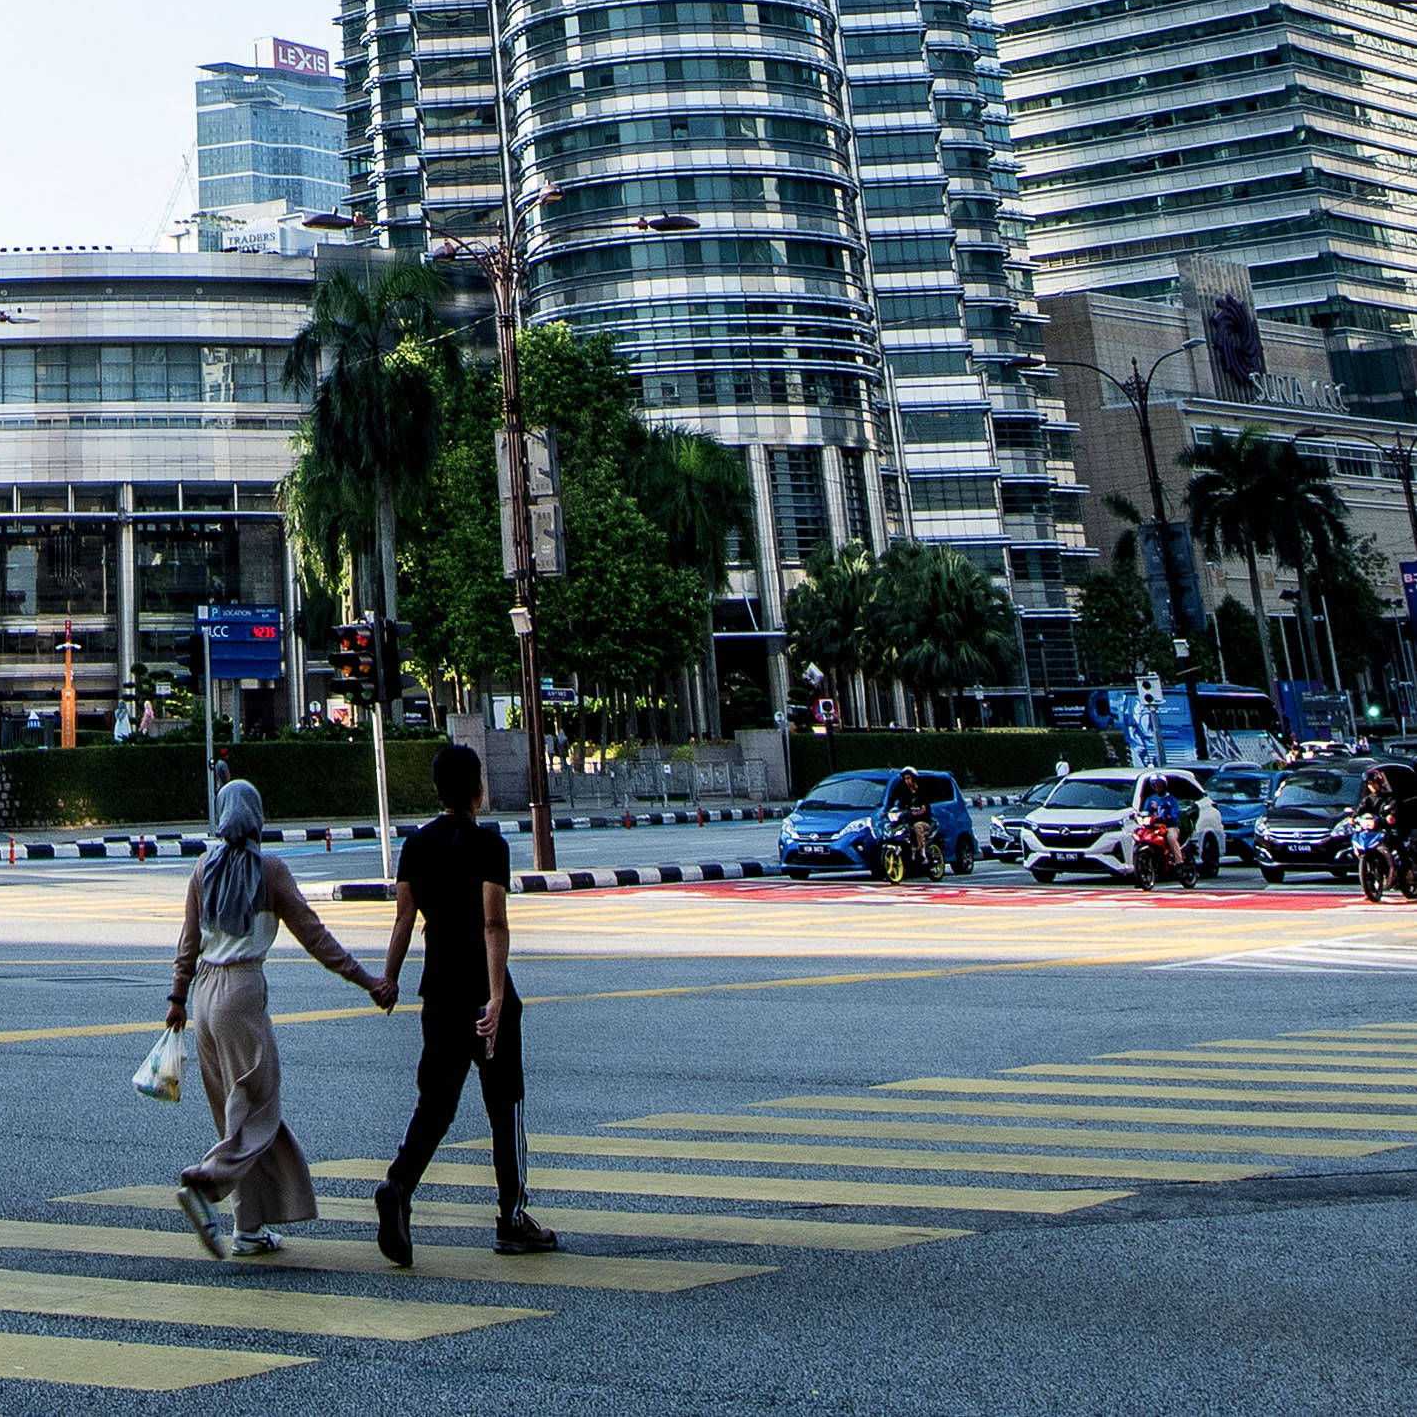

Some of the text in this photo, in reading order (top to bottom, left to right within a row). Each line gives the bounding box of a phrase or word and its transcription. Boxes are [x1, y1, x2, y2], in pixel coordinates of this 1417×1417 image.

[278, 45, 327, 72] LEXIS
[227, 232, 276, 245] TRADERS
[1249, 371, 1309, 406] SURIA
[222, 609, 252, 617] LOCATION
[202, 626, 229, 638] LCC
[253, 626, 276, 638] 4235
